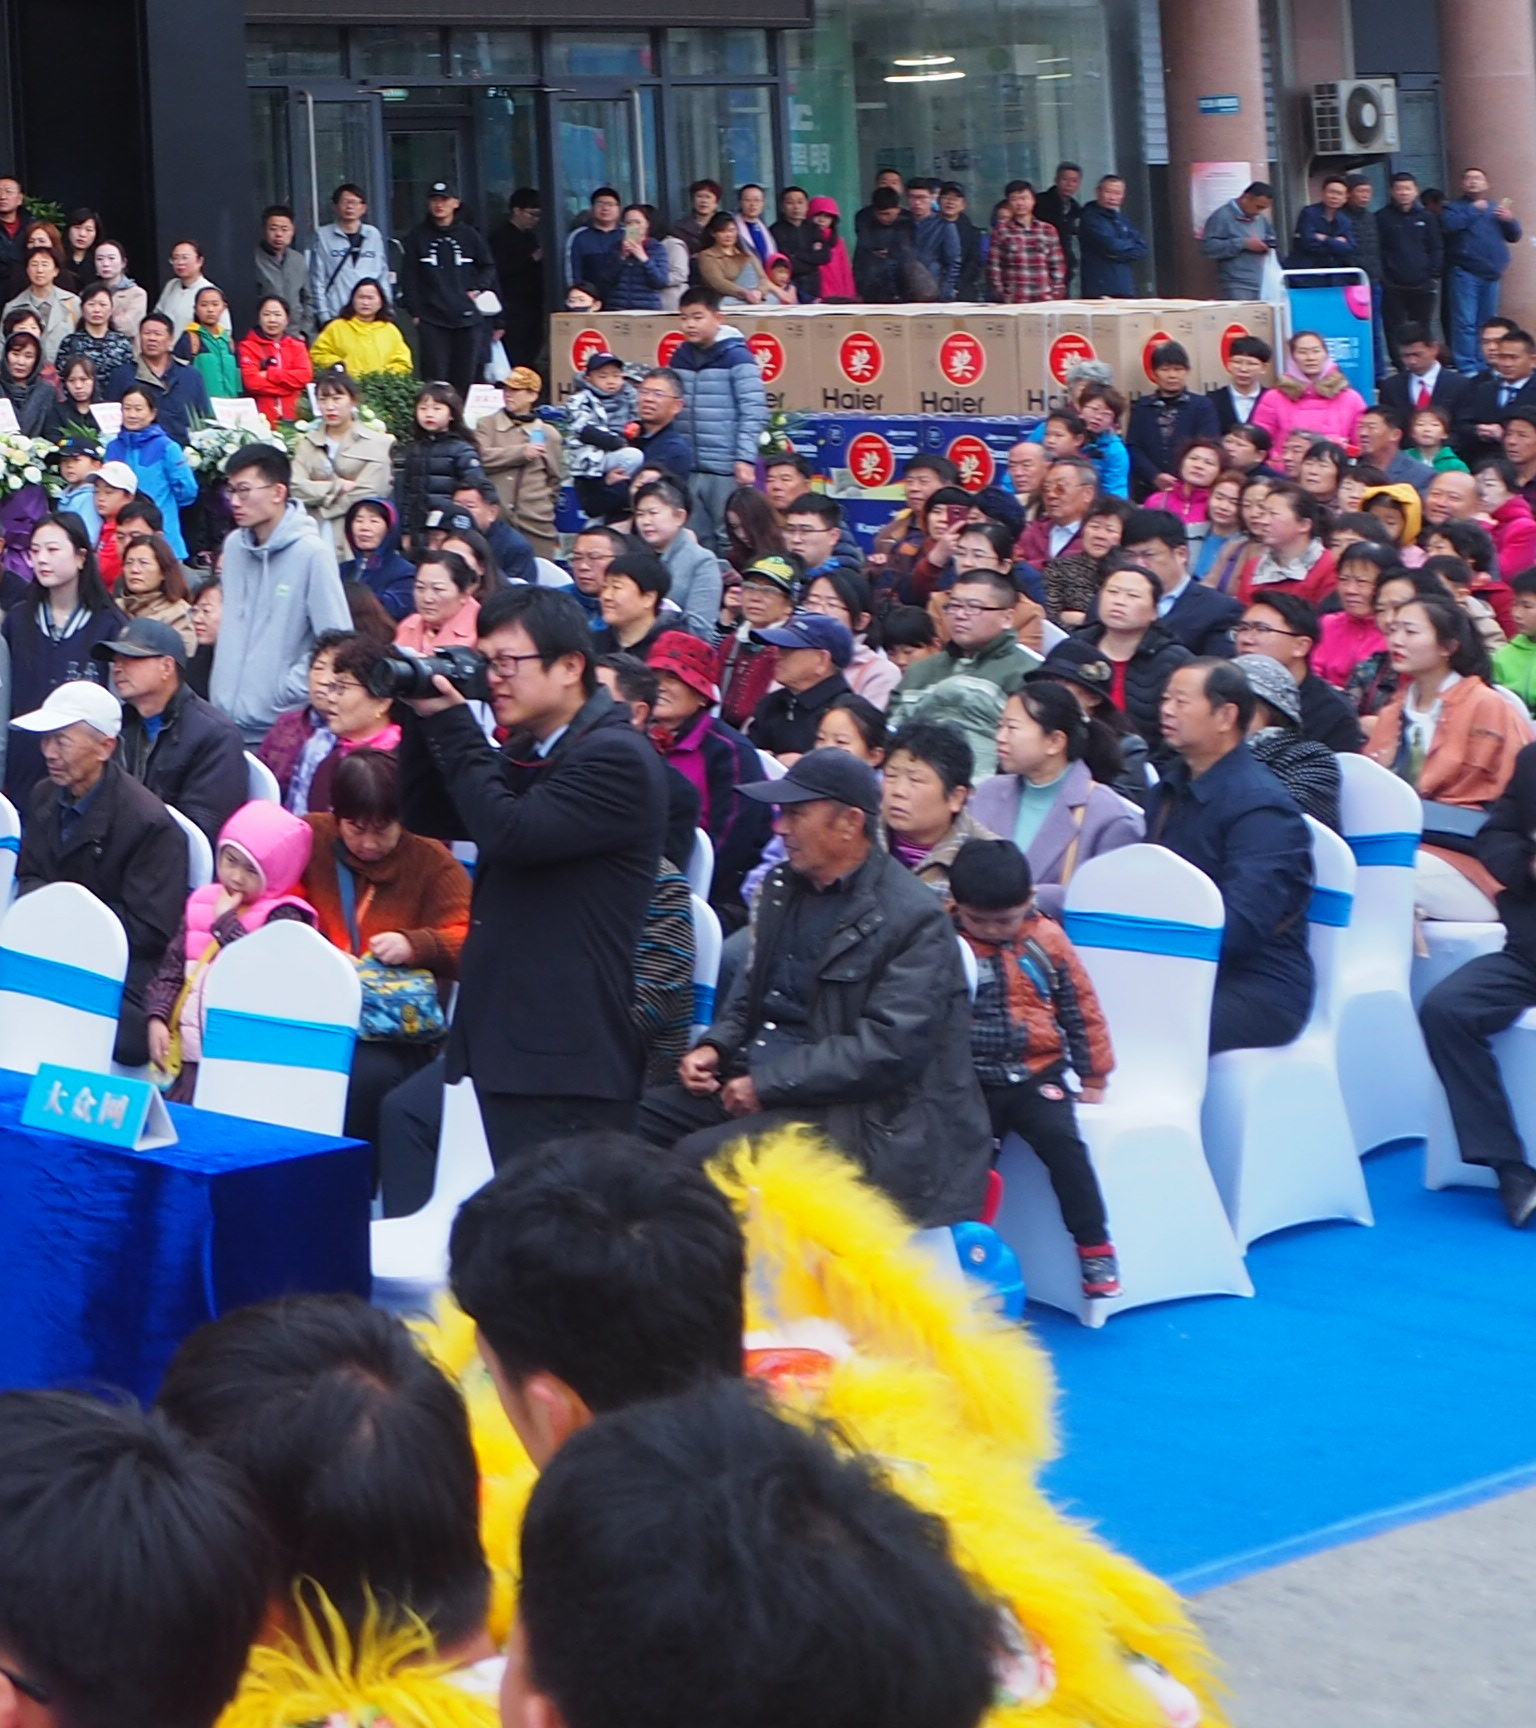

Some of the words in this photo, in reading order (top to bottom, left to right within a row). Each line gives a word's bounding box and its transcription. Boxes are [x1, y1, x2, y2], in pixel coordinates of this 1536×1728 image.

[822, 388, 884, 411] Haier
[921, 391, 986, 414] Haier
[1027, 389, 1070, 412] Hai
[41, 1080, 130, 1130] 大众网
